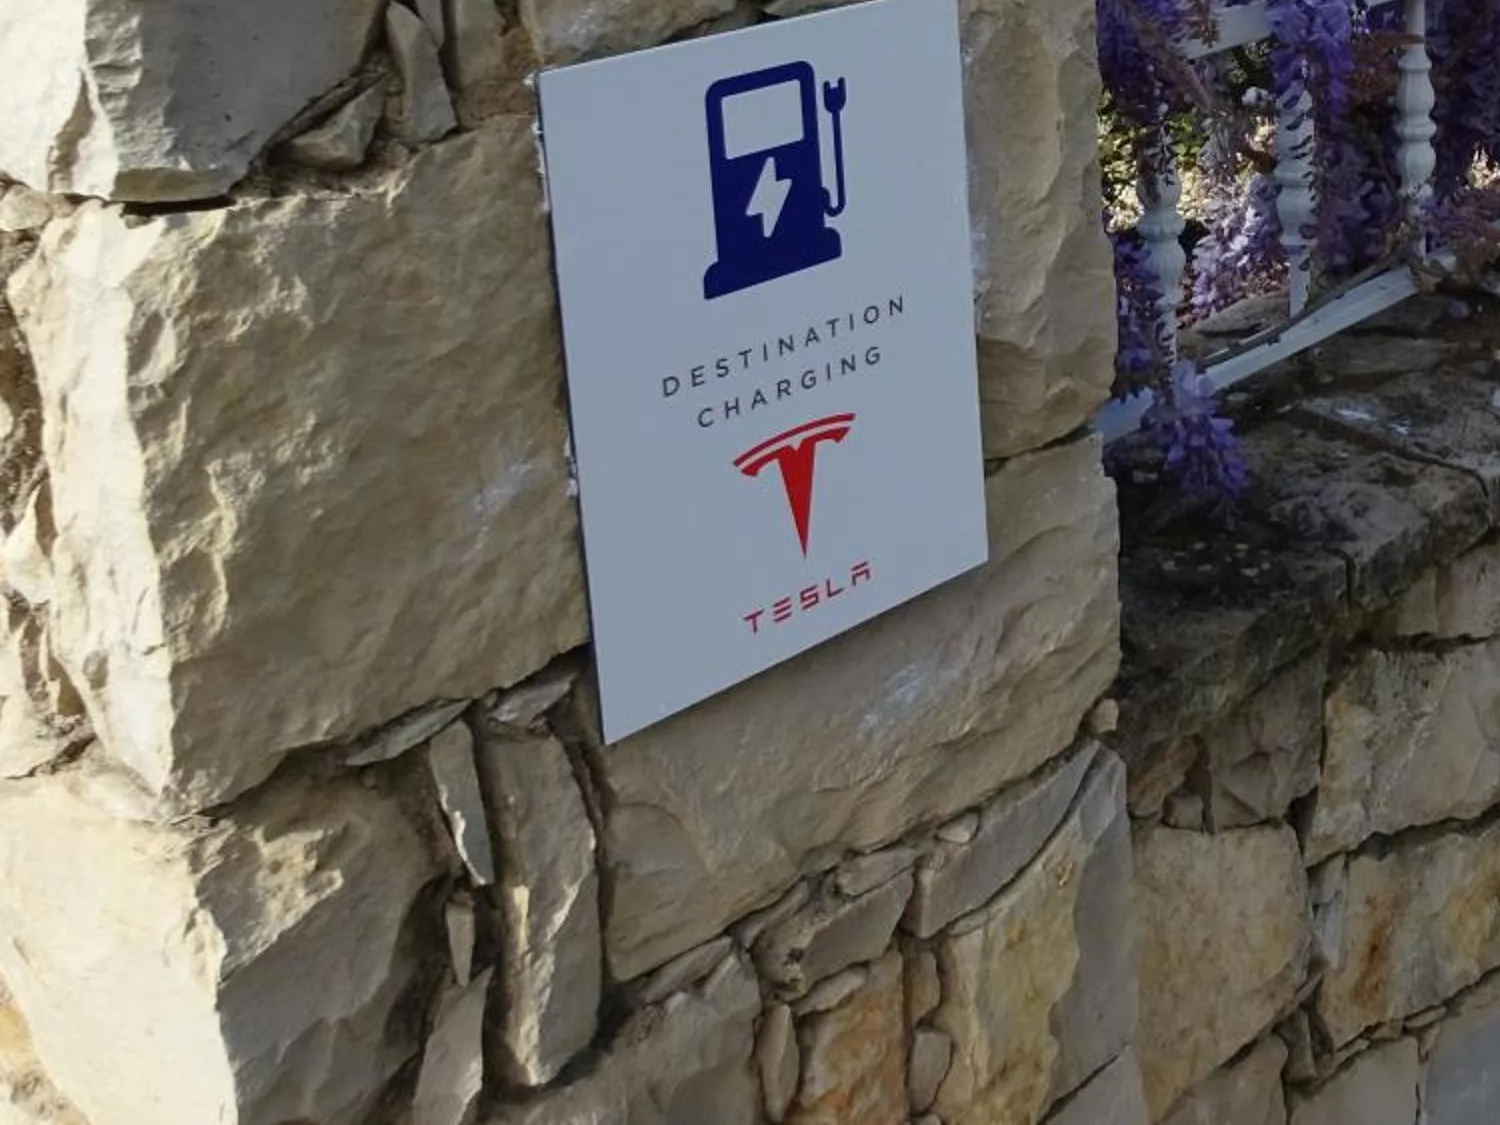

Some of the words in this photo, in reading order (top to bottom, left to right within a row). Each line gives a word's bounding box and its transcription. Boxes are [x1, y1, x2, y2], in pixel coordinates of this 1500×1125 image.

[661, 294, 905, 399] DESTINATION
[696, 345, 882, 428] CHARGING
[742, 560, 872, 635] TESLA
